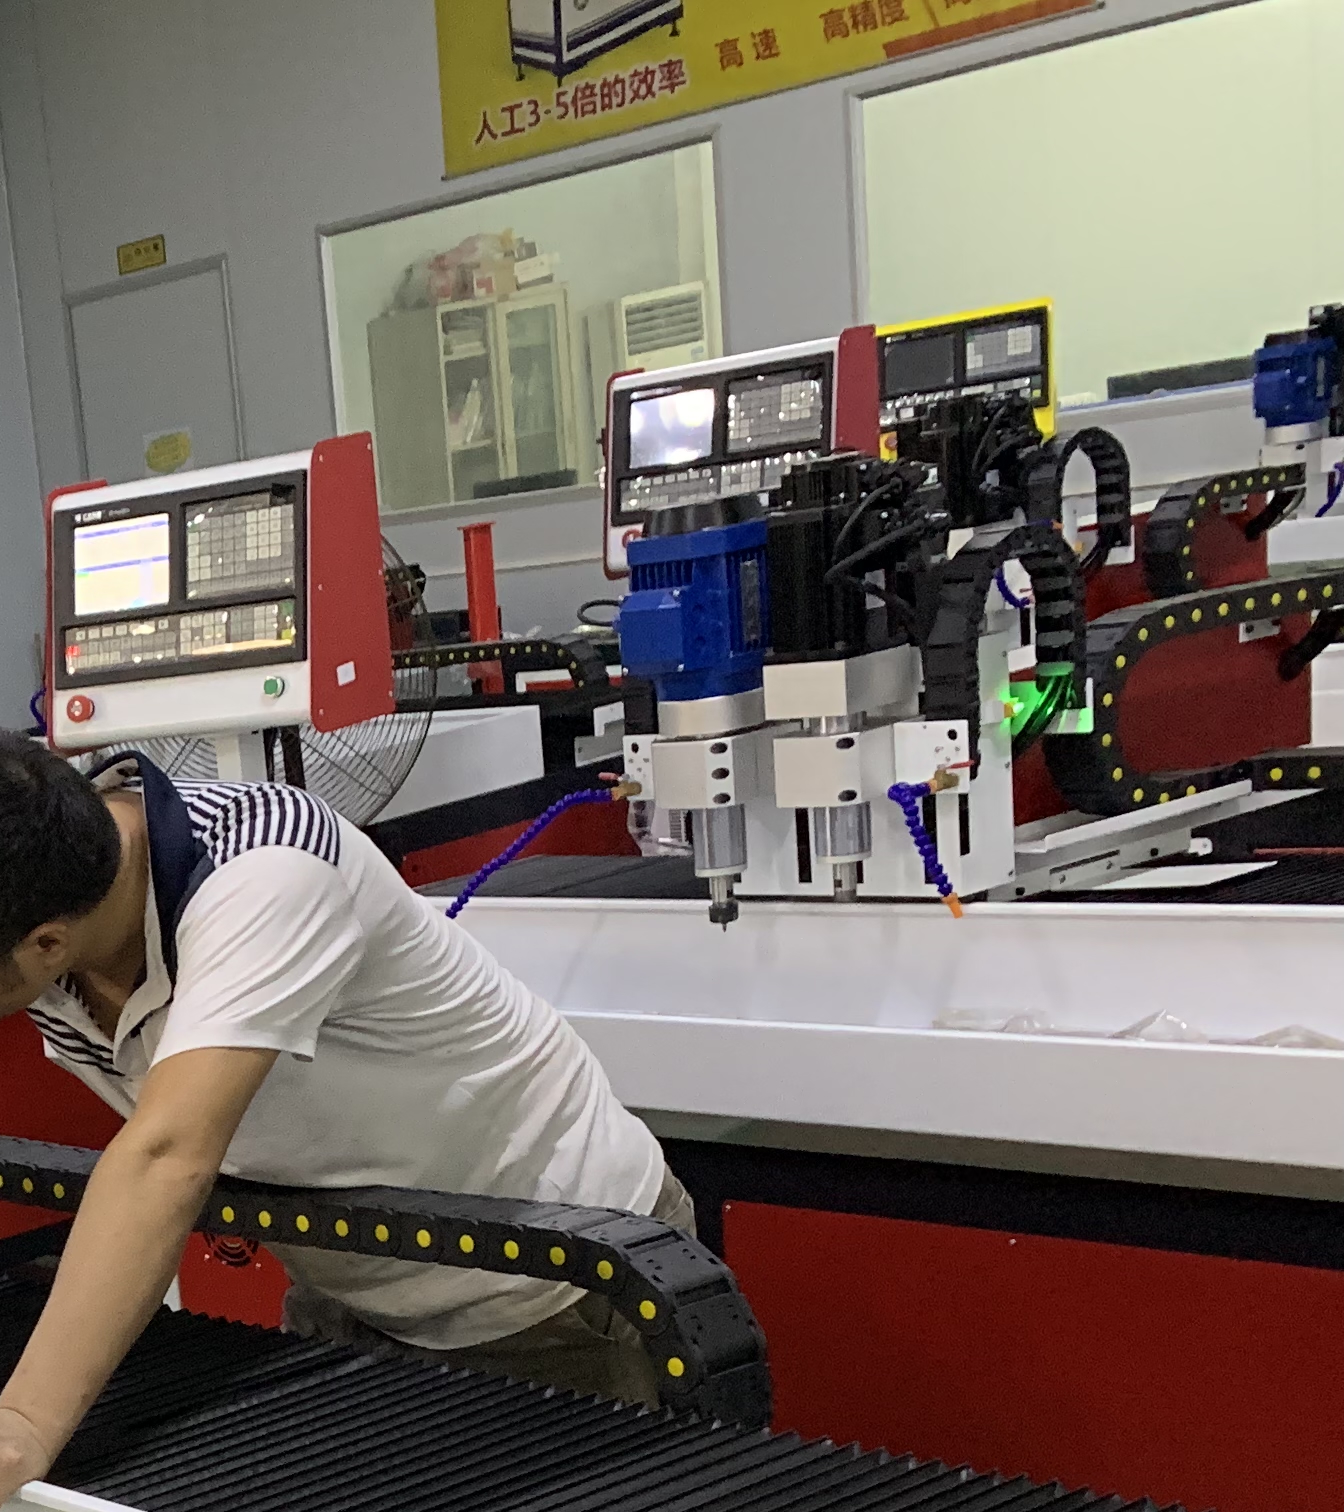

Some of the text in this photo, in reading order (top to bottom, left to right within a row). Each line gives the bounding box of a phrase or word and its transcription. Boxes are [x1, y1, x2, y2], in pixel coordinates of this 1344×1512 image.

[715, 28, 780, 71] 高速
[475, 59, 686, 144] 人工3-5倍的效率
